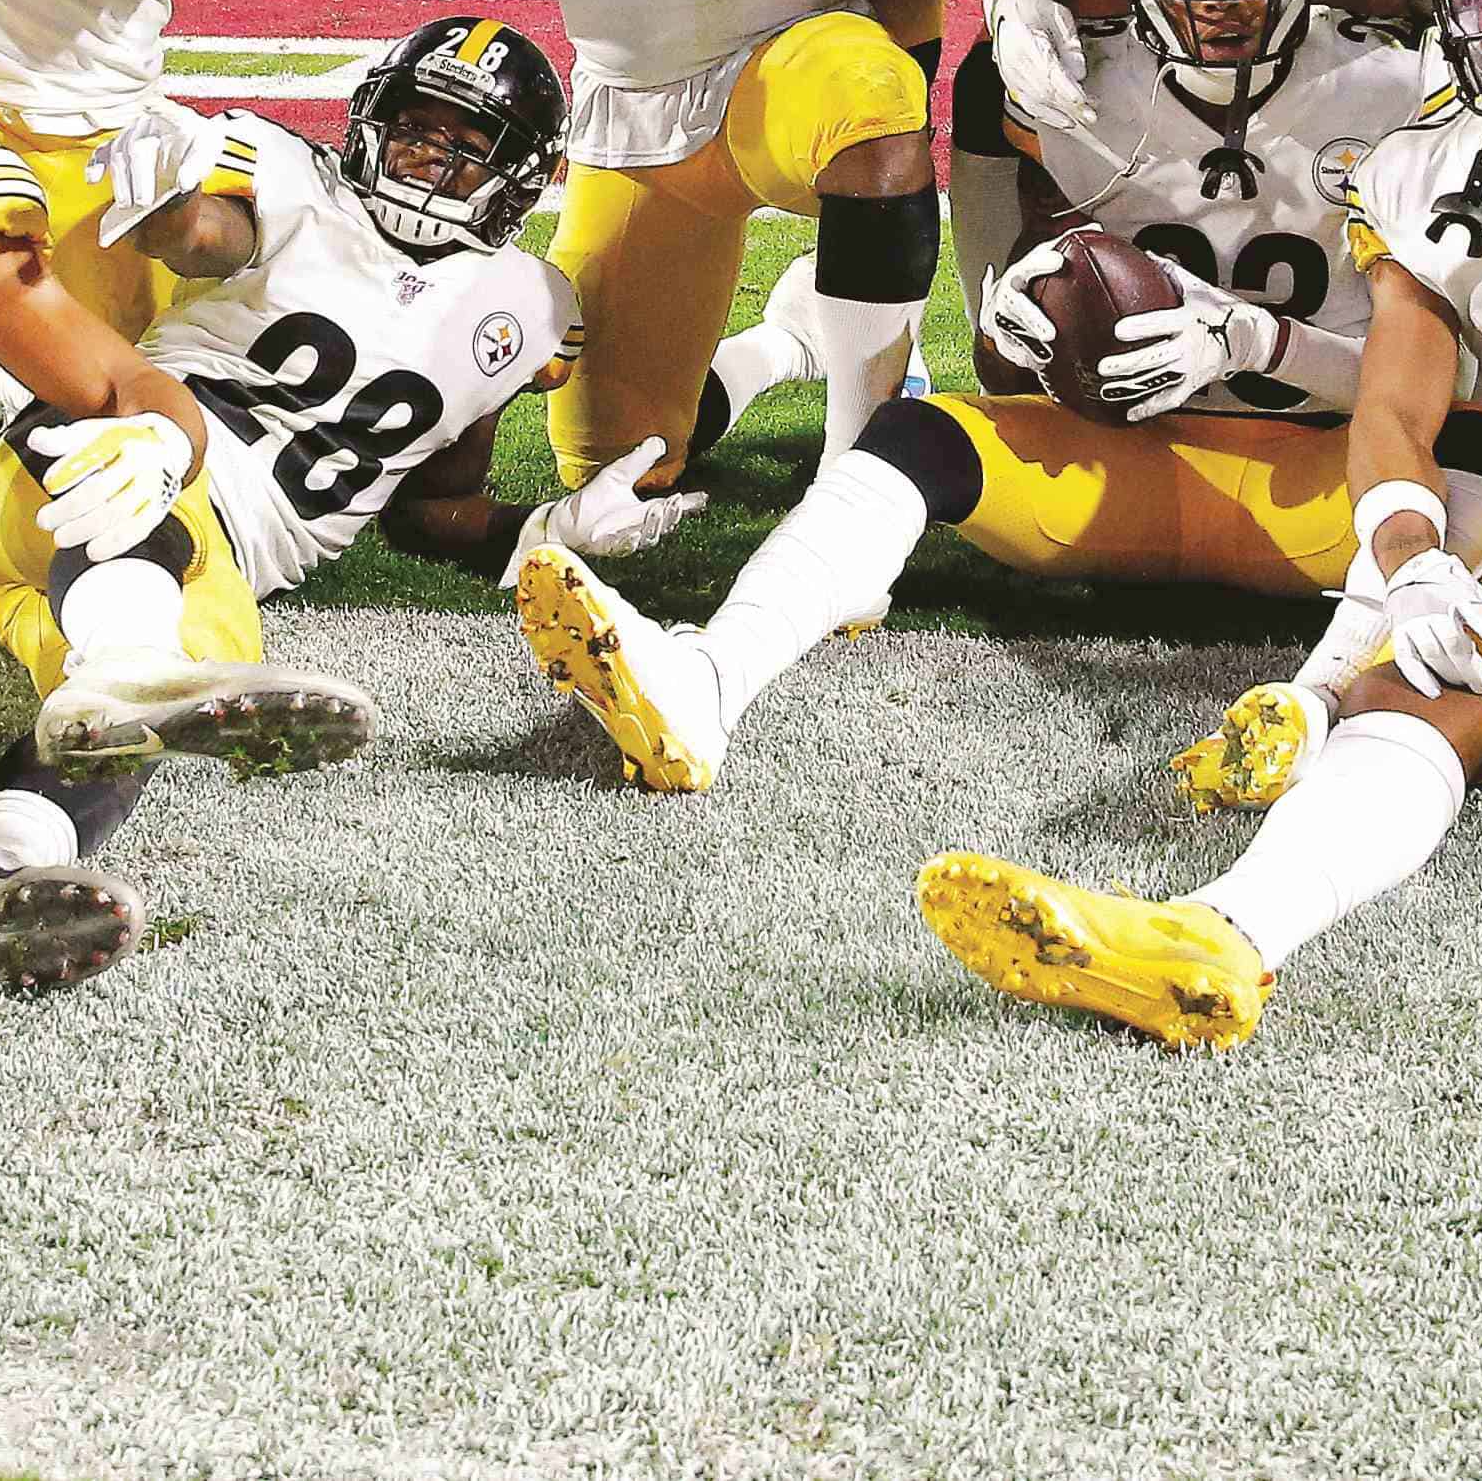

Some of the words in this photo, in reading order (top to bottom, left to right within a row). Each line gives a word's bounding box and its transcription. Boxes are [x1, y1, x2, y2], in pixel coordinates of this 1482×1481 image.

[436, 26, 509, 73] 28
[439, 58, 478, 83] Steelers
[185, 311, 445, 521] 28
